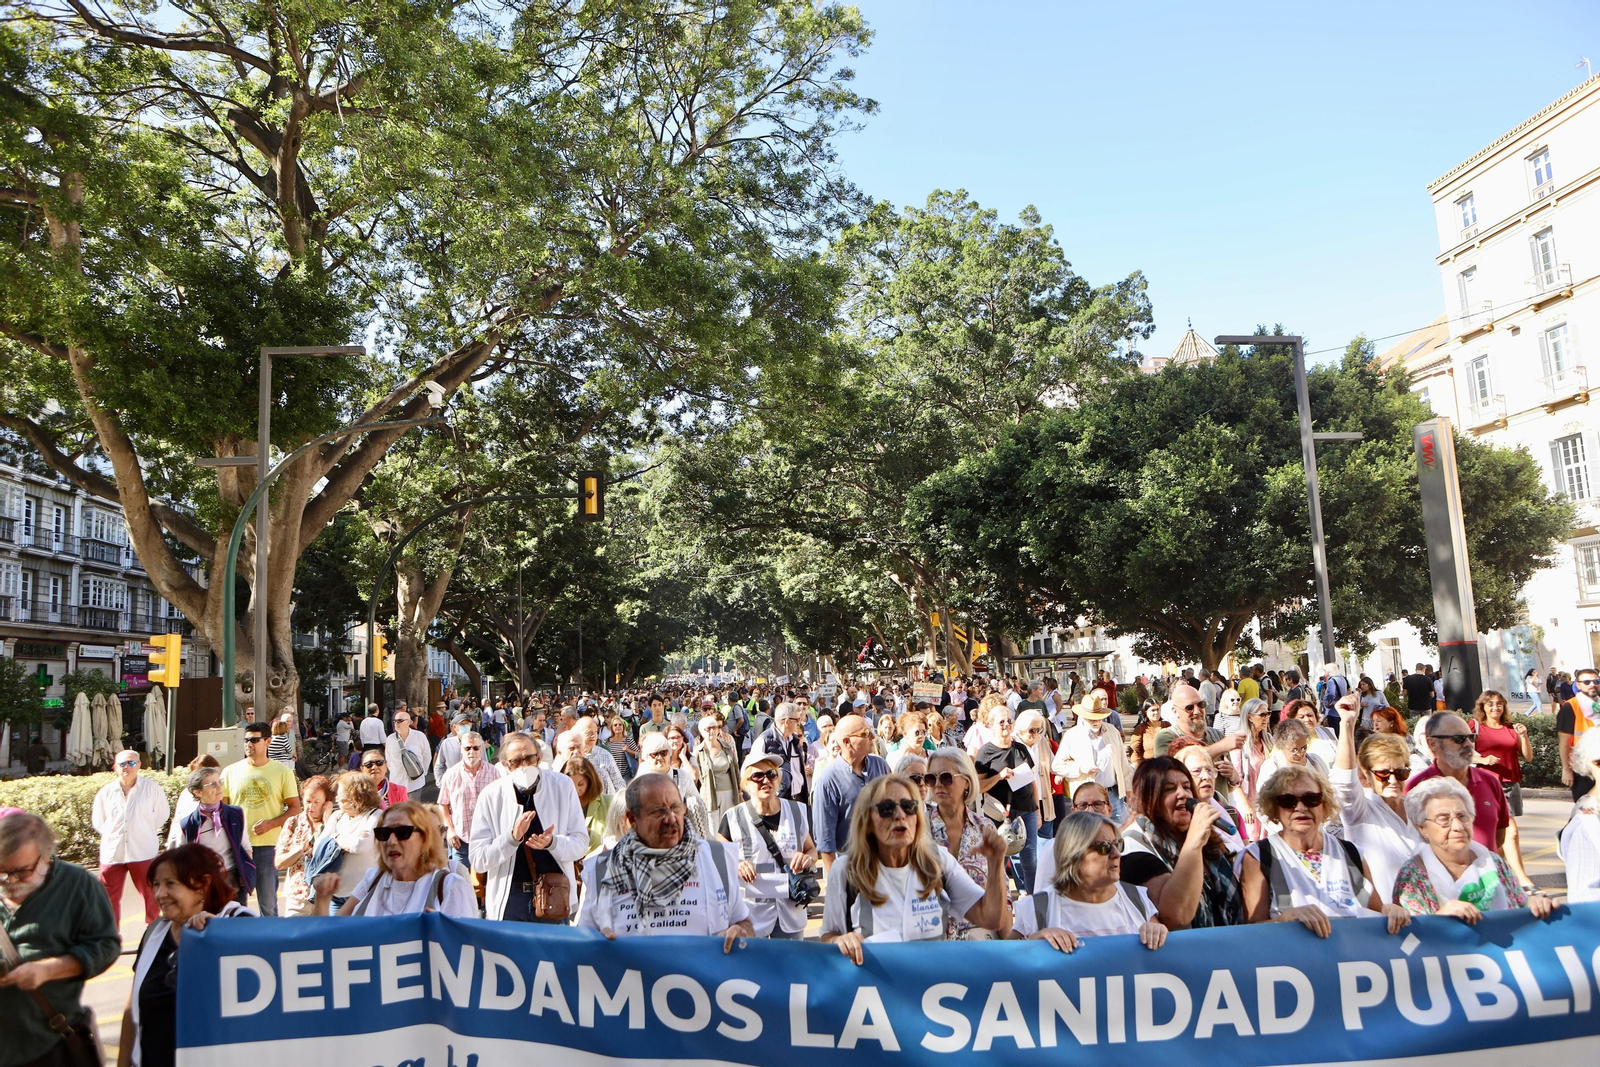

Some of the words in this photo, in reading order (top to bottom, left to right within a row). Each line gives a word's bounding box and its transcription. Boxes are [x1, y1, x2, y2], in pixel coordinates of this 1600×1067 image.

[1511, 691, 1524, 699] RKS
[620, 903, 635, 911] Por
[911, 903, 939, 912] blanca
[626, 924, 632, 932] y
[650, 919, 687, 928] calidad
[219, 940, 764, 1042] DEFENDAMOS
[789, 983, 901, 1051] LA
[920, 965, 1315, 1053] SANIDAD
[1337, 932, 1600, 1030] PÚBLI
